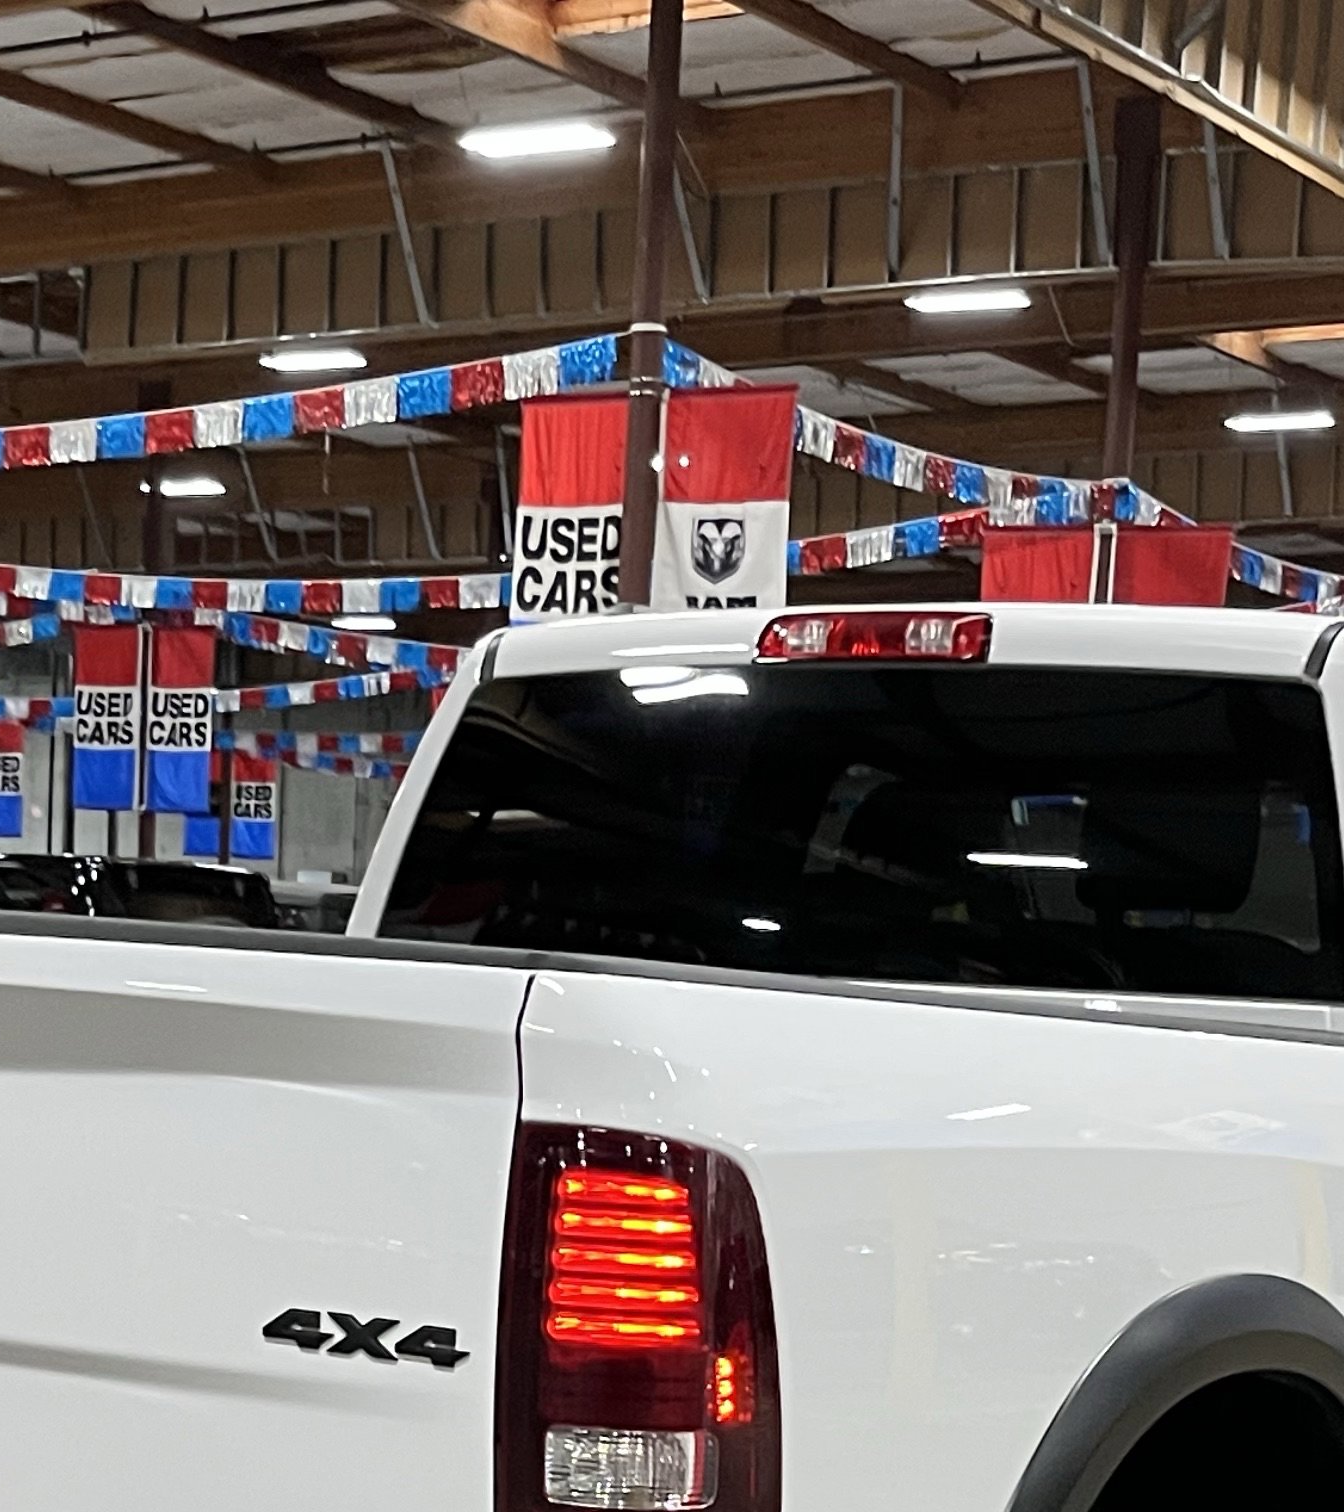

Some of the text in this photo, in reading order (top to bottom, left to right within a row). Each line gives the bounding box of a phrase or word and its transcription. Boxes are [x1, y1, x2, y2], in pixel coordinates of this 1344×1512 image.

[521, 516, 624, 563] USED
[516, 566, 620, 614] CARS
[77, 690, 134, 718] USED
[152, 692, 209, 719] USED
[76, 718, 134, 745] CARS
[149, 721, 208, 747] CARS
